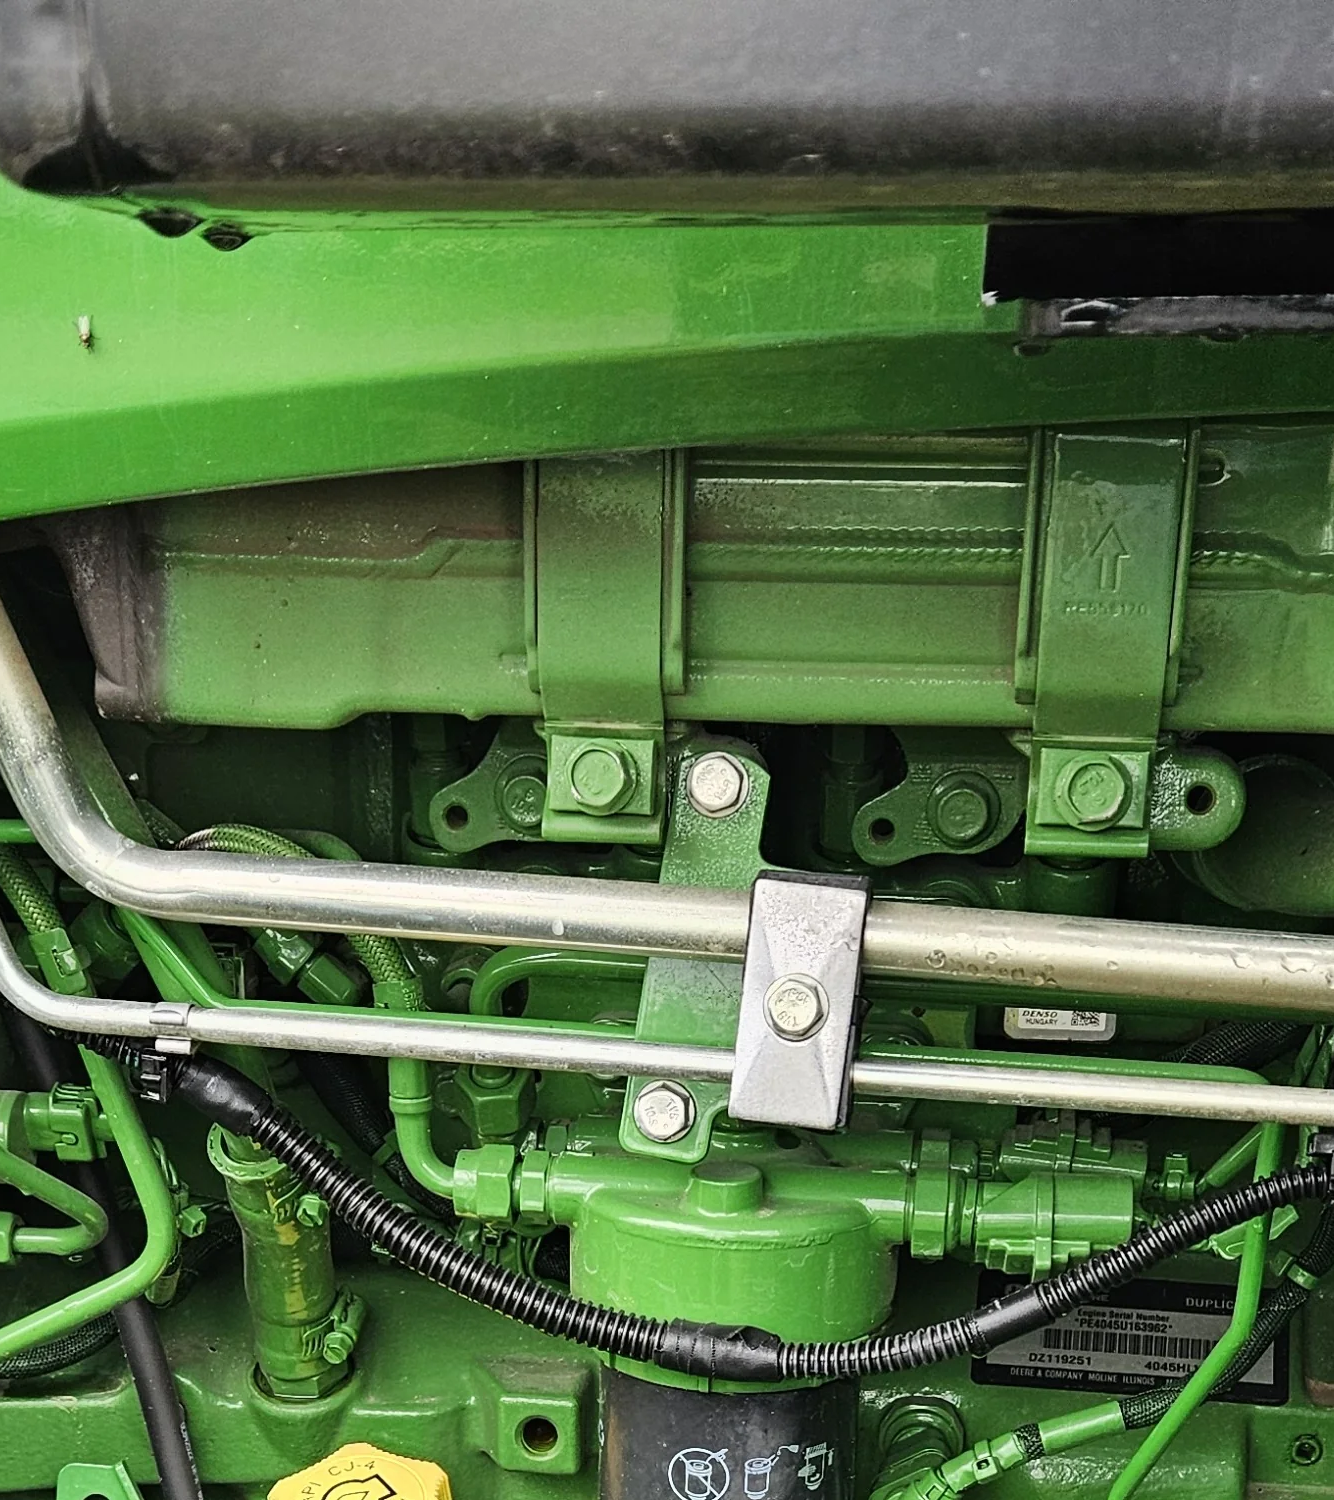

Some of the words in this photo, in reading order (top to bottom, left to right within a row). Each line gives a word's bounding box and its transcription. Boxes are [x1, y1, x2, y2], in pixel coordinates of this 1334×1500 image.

[1021, 1010, 1058, 1019] DENSO
[1025, 1018, 1059, 1026] HUNGARY
[1077, 1308, 1107, 1318] Engine
[1108, 1310, 1134, 1320] Serial
[1136, 1311, 1170, 1322] Number
[1028, 1352, 1092, 1366] DZ119251
[1010, 1367, 1035, 1378] DEERE
[1044, 1369, 1083, 1381] COMPANY
[1088, 1372, 1118, 1383] MOLINE
[1122, 1373, 1155, 1385] ILLINOIS
[327, 1460, 376, 1477] CJ-4
